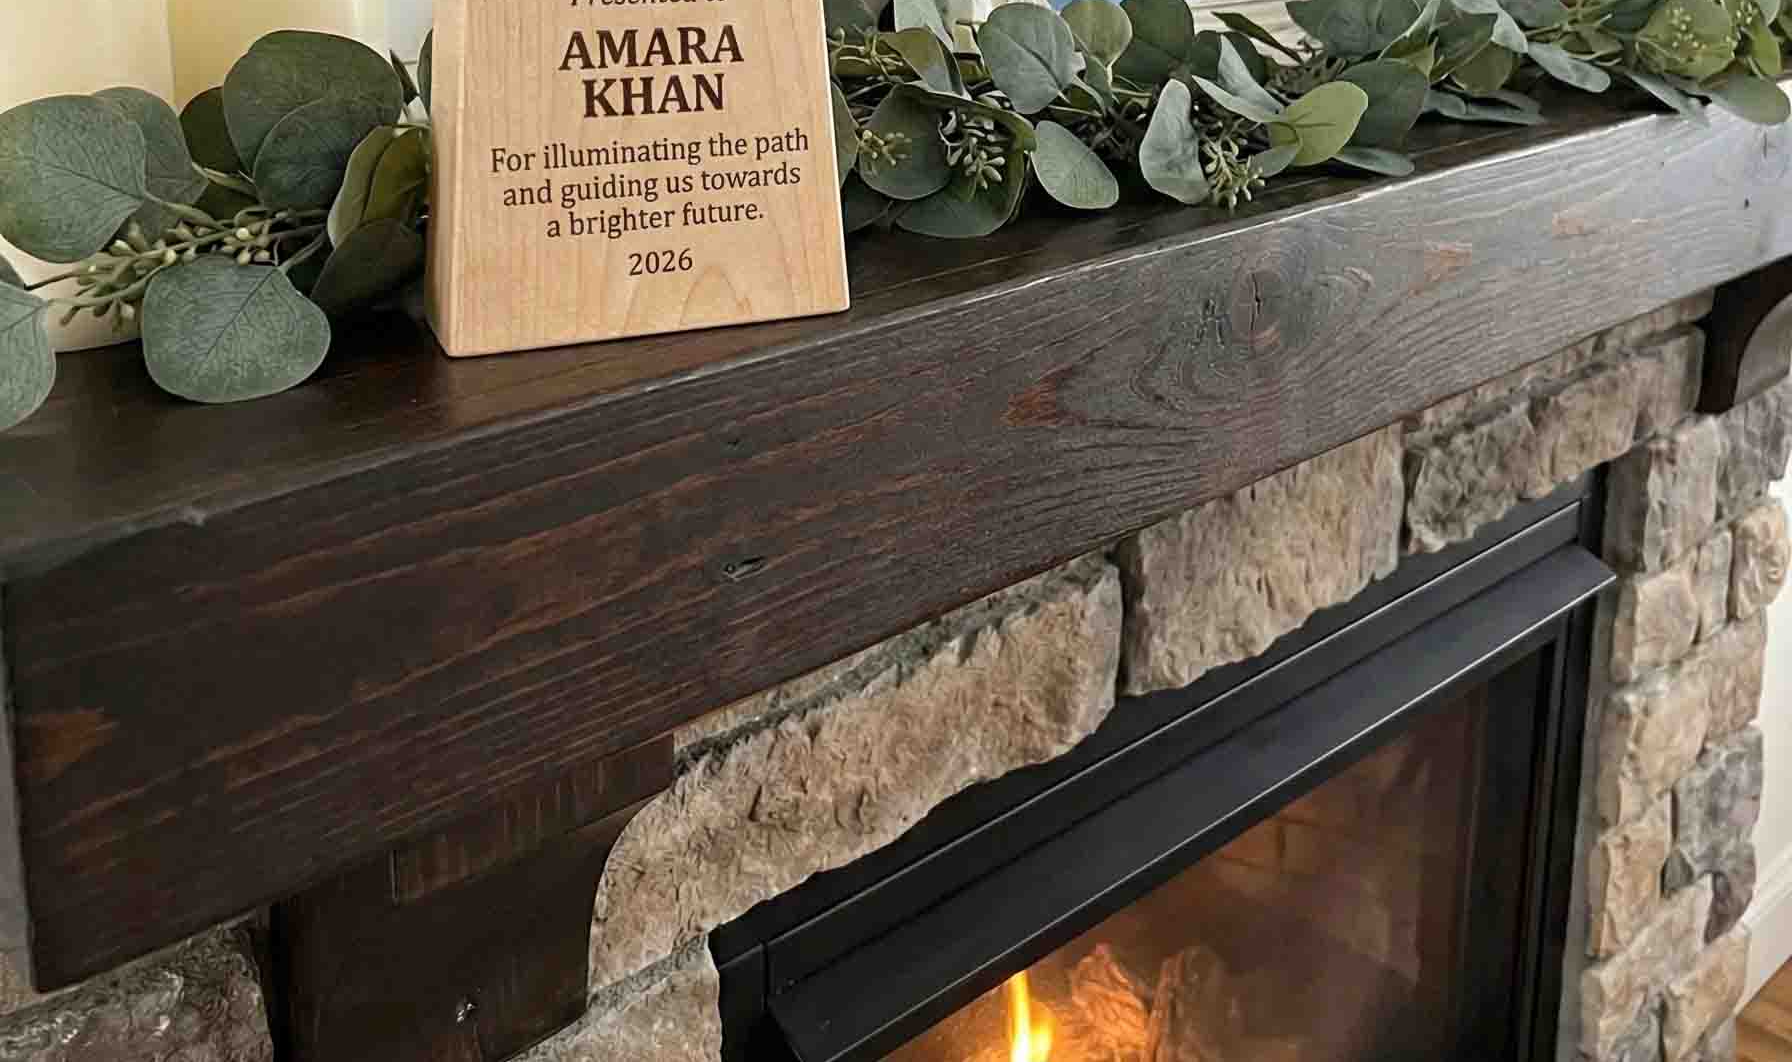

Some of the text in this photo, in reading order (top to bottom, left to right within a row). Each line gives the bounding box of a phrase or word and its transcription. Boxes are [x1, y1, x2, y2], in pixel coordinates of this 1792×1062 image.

[557, 24, 745, 71] AMARA
[581, 72, 725, 119] KHAN
[491, 127, 809, 173] For illuminating the path
[503, 161, 801, 208] and guiding us towards
[546, 201, 764, 240] a brighter future.
[628, 247, 693, 277] 2026
